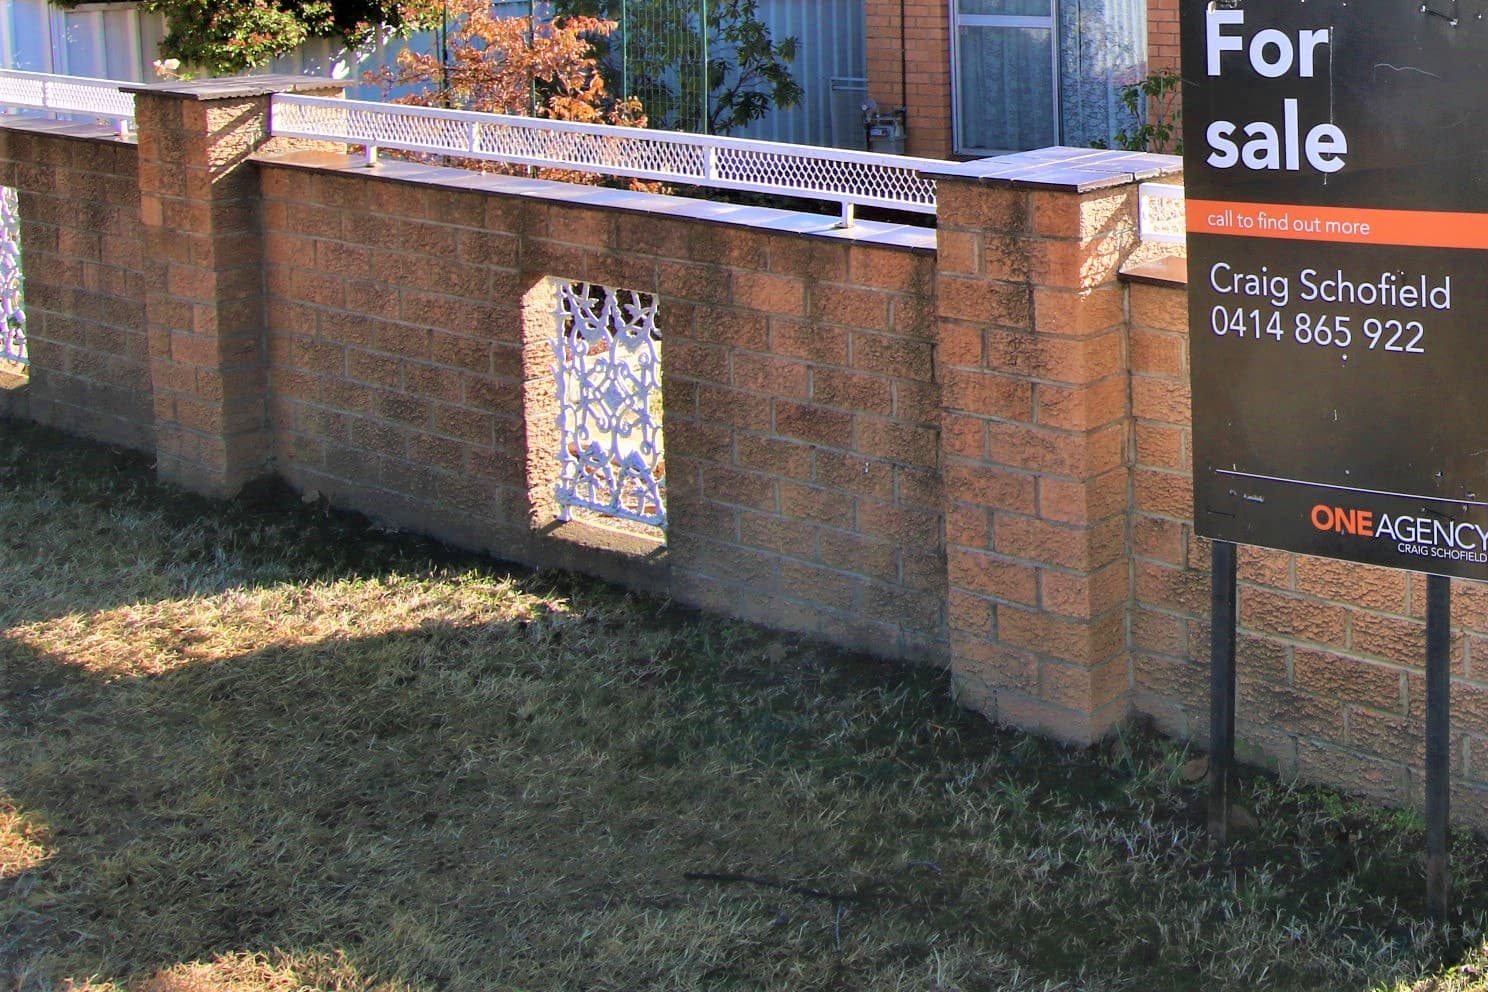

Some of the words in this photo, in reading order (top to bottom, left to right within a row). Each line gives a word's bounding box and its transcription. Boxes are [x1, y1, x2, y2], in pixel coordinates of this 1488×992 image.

[1205, 9, 1330, 78] For
[1206, 98, 1348, 173] sale
[1207, 209, 1233, 227] call
[1236, 214, 1255, 229] to
[1257, 211, 1289, 231] find
[1292, 217, 1322, 233] out
[1325, 221, 1371, 236] more
[1210, 262, 1289, 307] Craig
[1299, 268, 1451, 309] Schofield
[1211, 305, 1284, 341] 0414
[1294, 312, 1352, 347] 865
[1363, 318, 1425, 353] 922
[1397, 542, 1429, 556] CRAIG
[1430, 547, 1488, 563] SCHOFIELD
